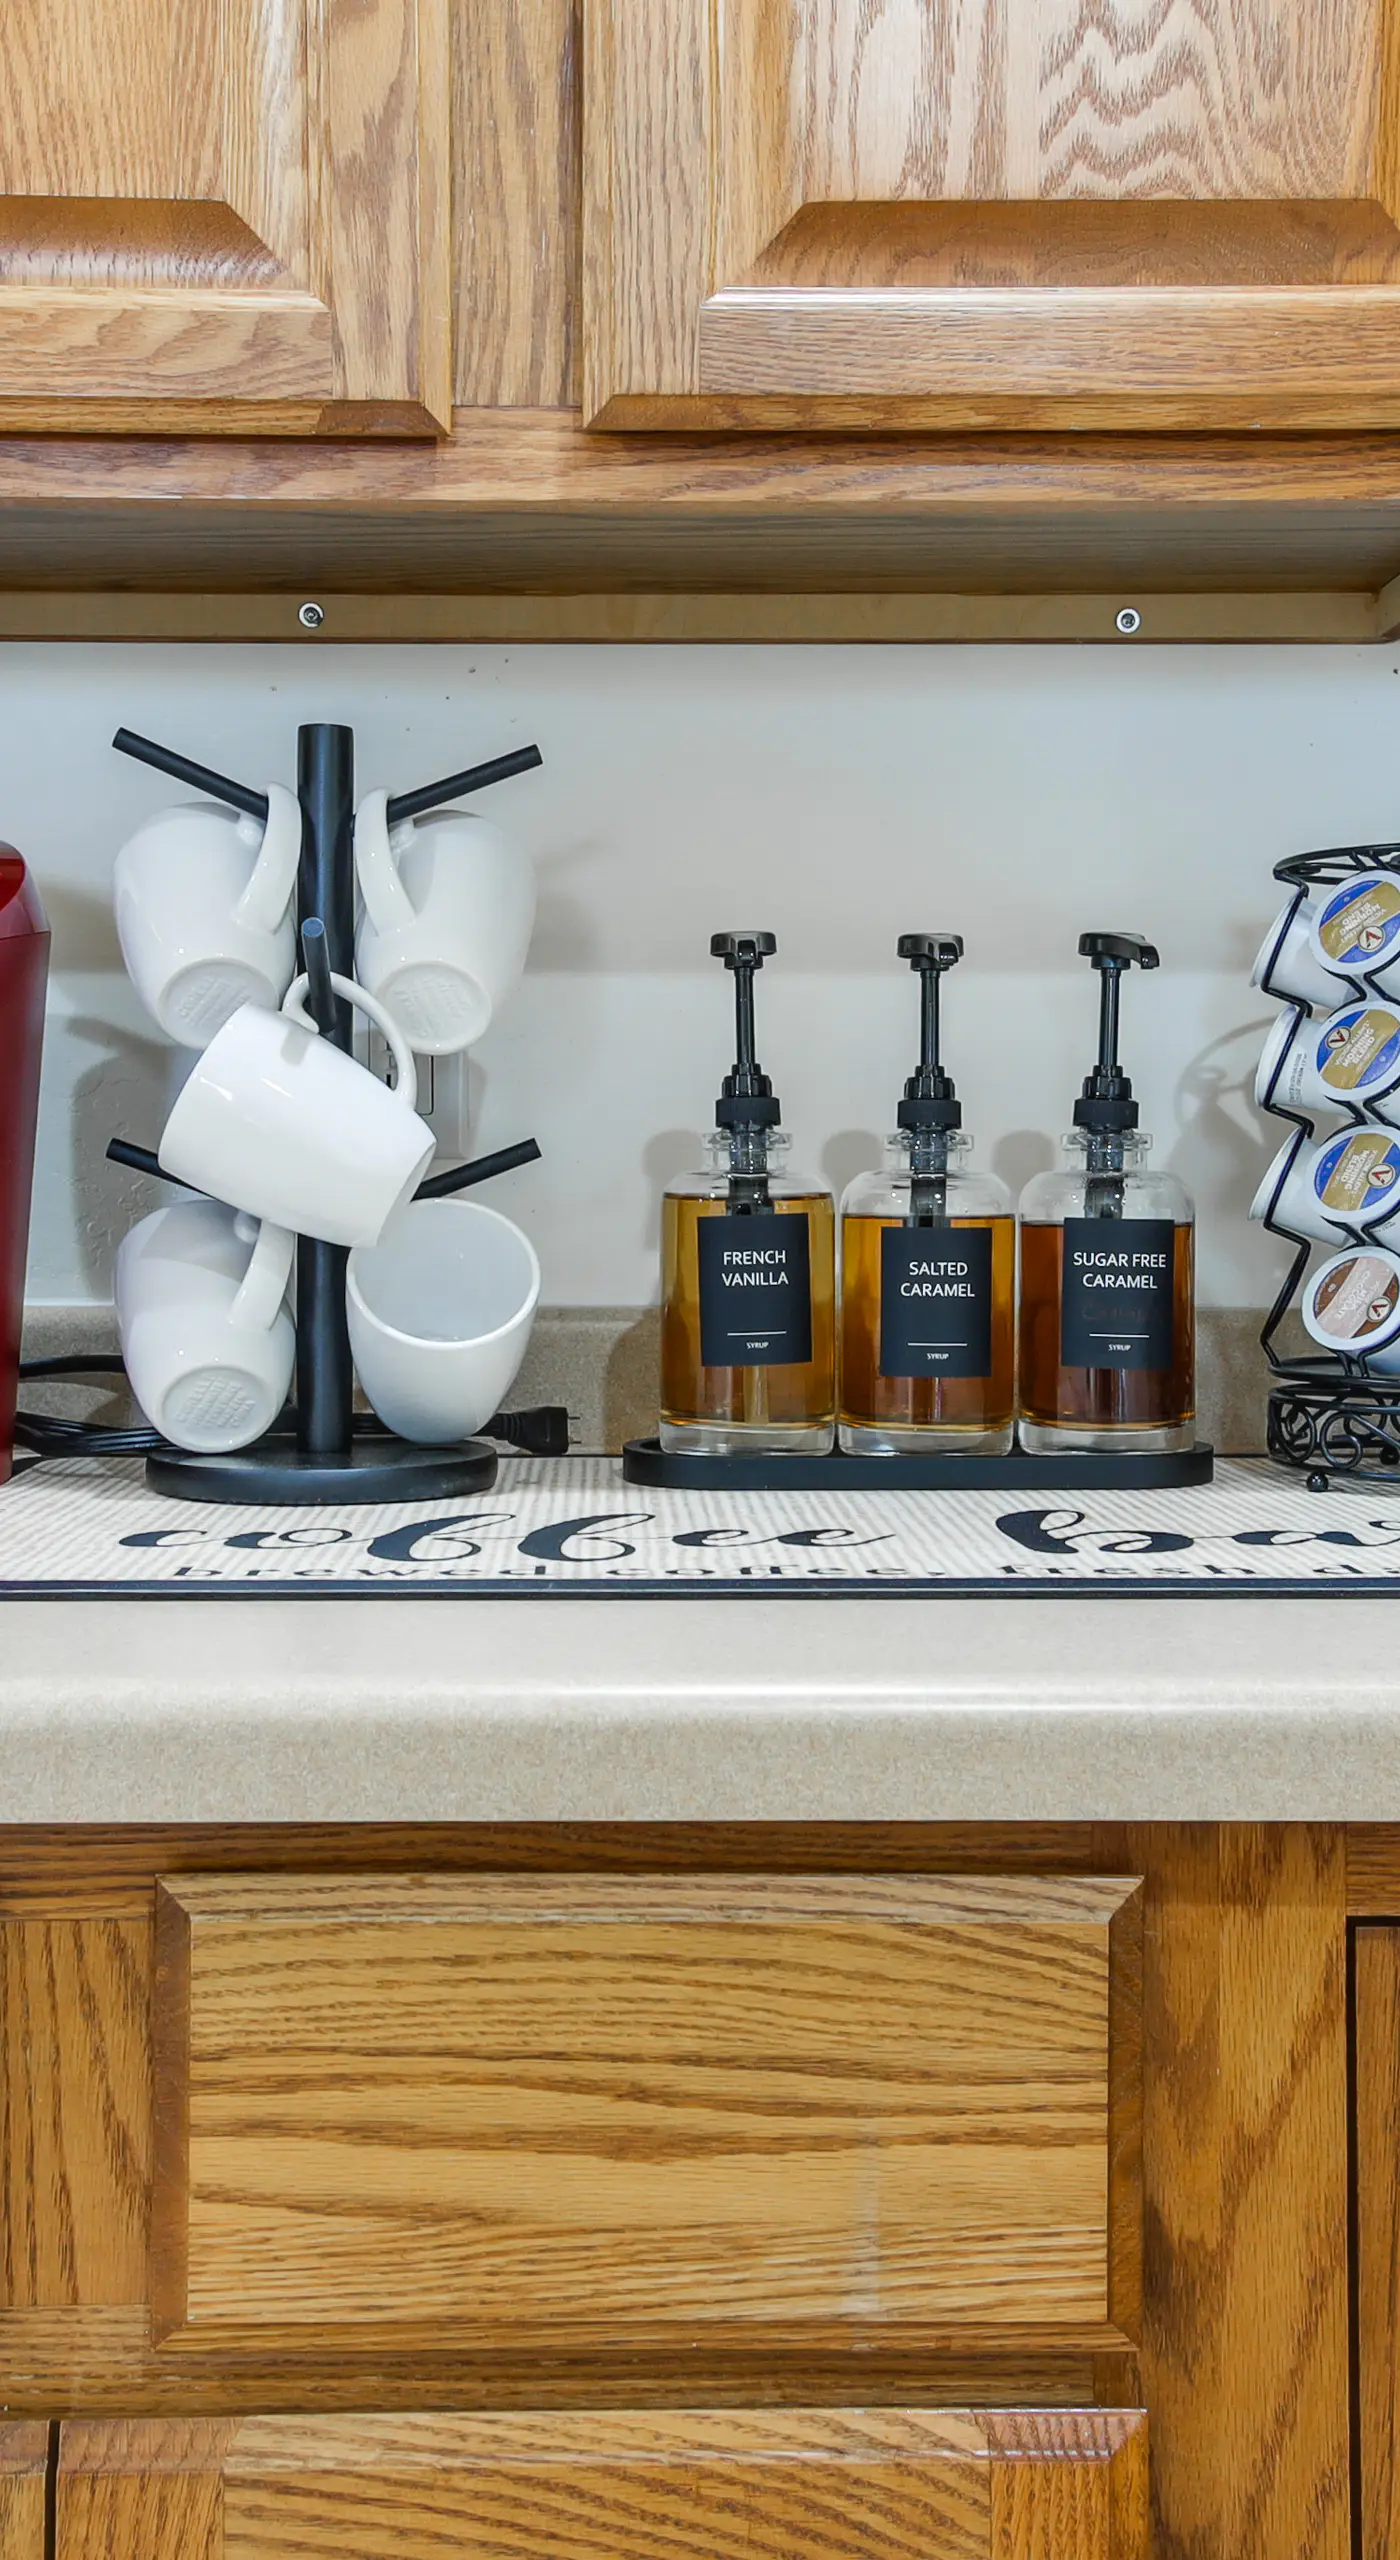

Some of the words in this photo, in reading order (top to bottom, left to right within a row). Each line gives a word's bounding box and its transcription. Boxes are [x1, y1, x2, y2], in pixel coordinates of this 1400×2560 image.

[1341, 1027, 1374, 1067] MORNING
[1351, 1035, 1375, 1064] BLEND
[723, 1249, 787, 1266] FRENCH
[1073, 1251, 1129, 1268] SUGAR
[1132, 1253, 1167, 1268] FREE
[909, 1261, 968, 1276] SALTED
[721, 1271, 789, 1287] VANILLA
[1082, 1273, 1158, 1289] CARAMEL
[900, 1282, 976, 1297] CARAMEL
[746, 1341, 769, 1349] SYRUP
[118, 1512, 897, 1562] coffee
[173, 1564, 547, 1577] brewed
[996, 1563, 1258, 1576] fresh
